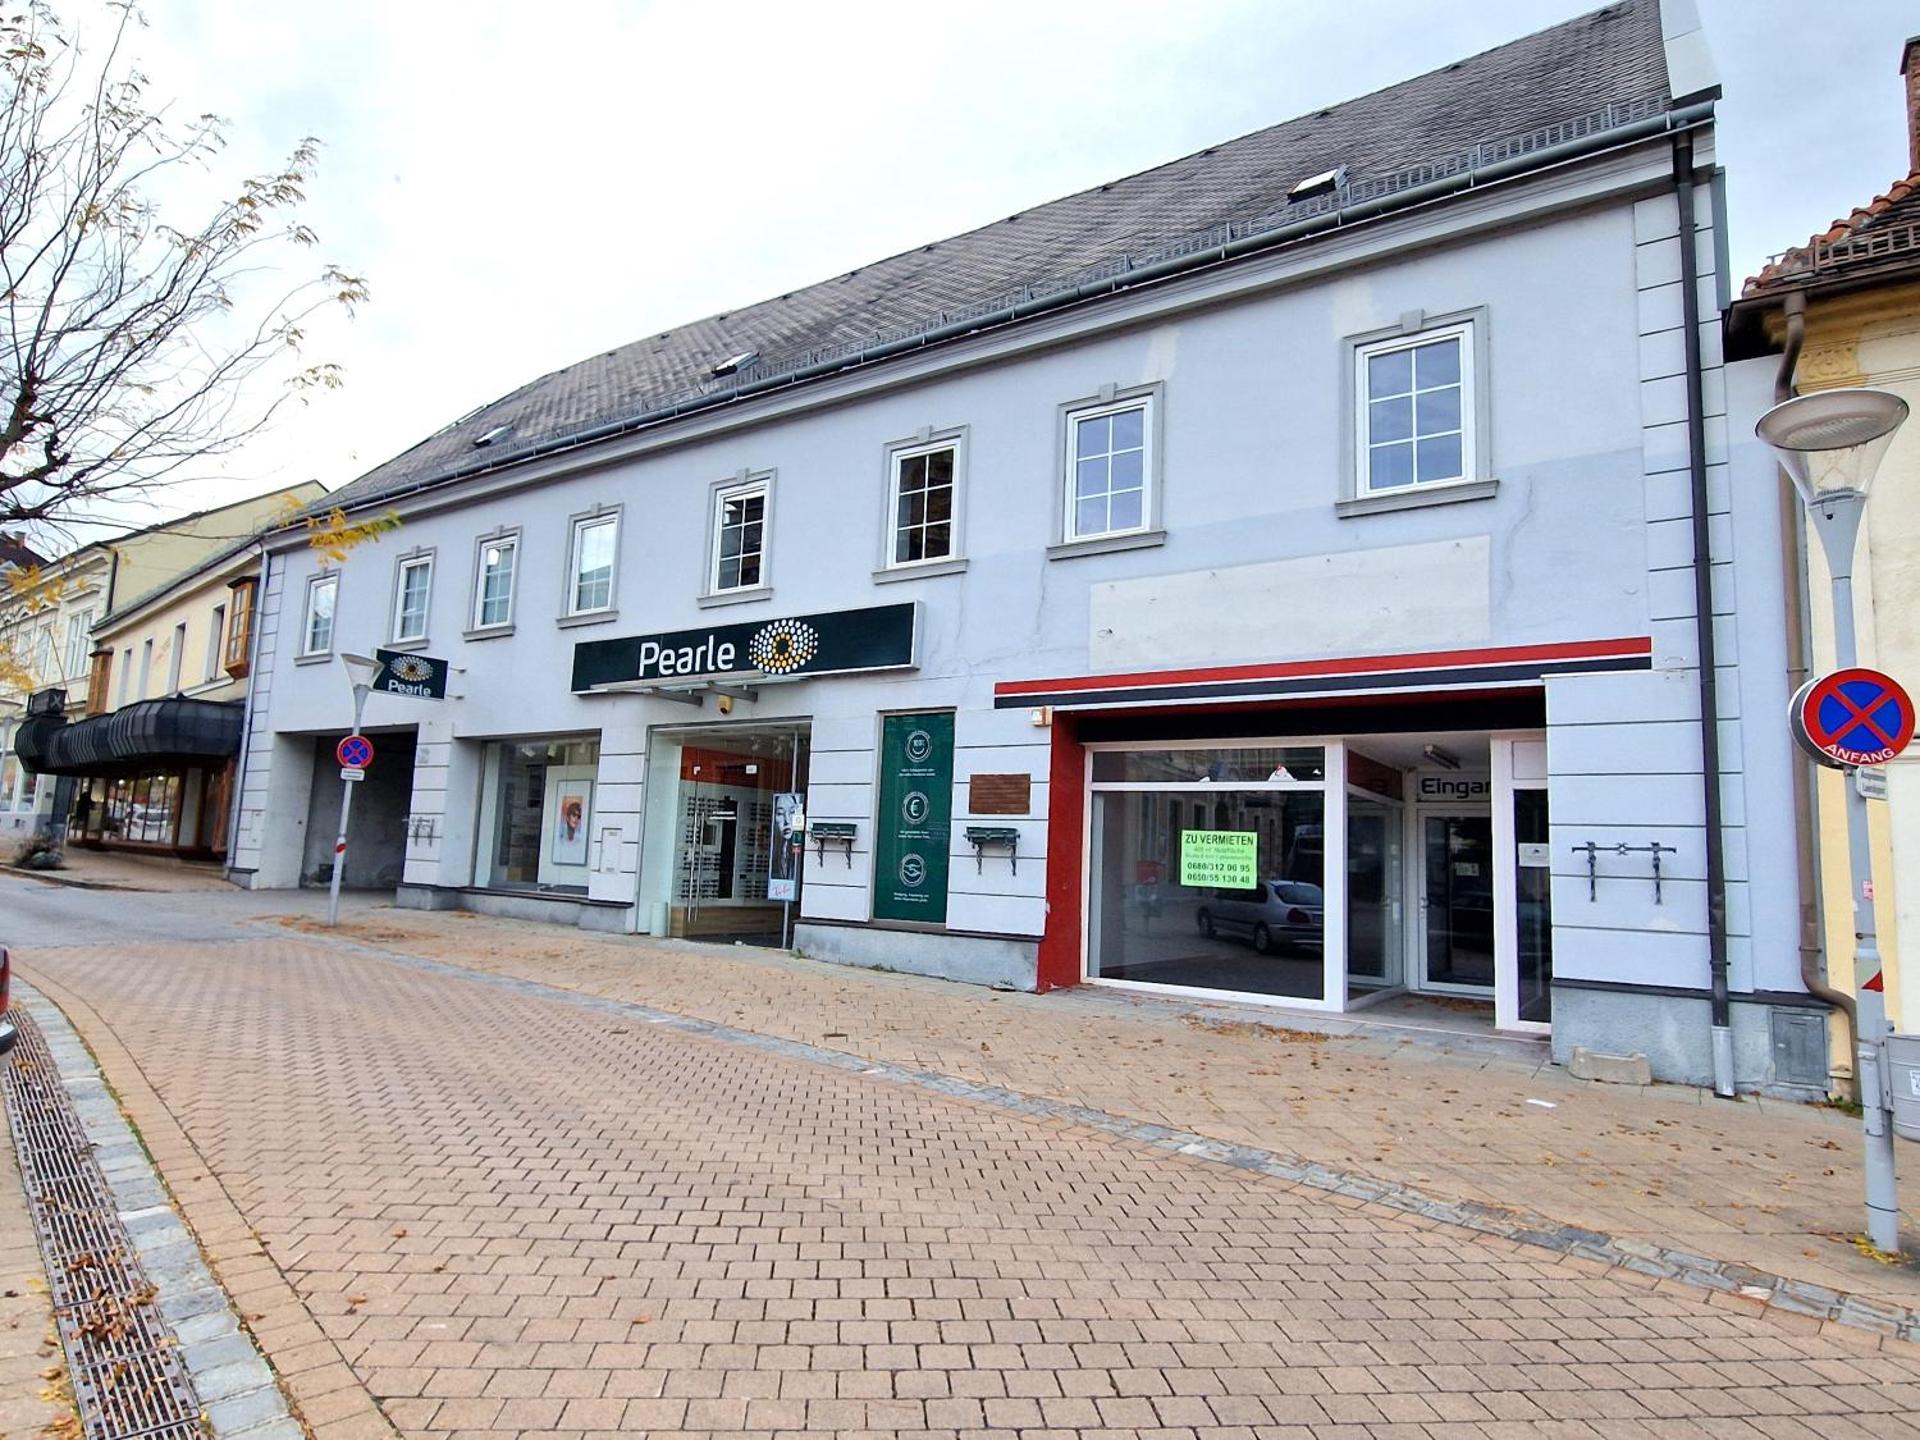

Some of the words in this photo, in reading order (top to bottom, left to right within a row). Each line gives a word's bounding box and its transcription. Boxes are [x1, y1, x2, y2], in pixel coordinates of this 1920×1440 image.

[639, 634, 735, 677] Pearle
[388, 679, 432, 697] Pearle
[1823, 744, 1895, 763] ANFANG
[1185, 834, 1197, 844] ZU
[1200, 834, 1254, 846] VERMIETEN
